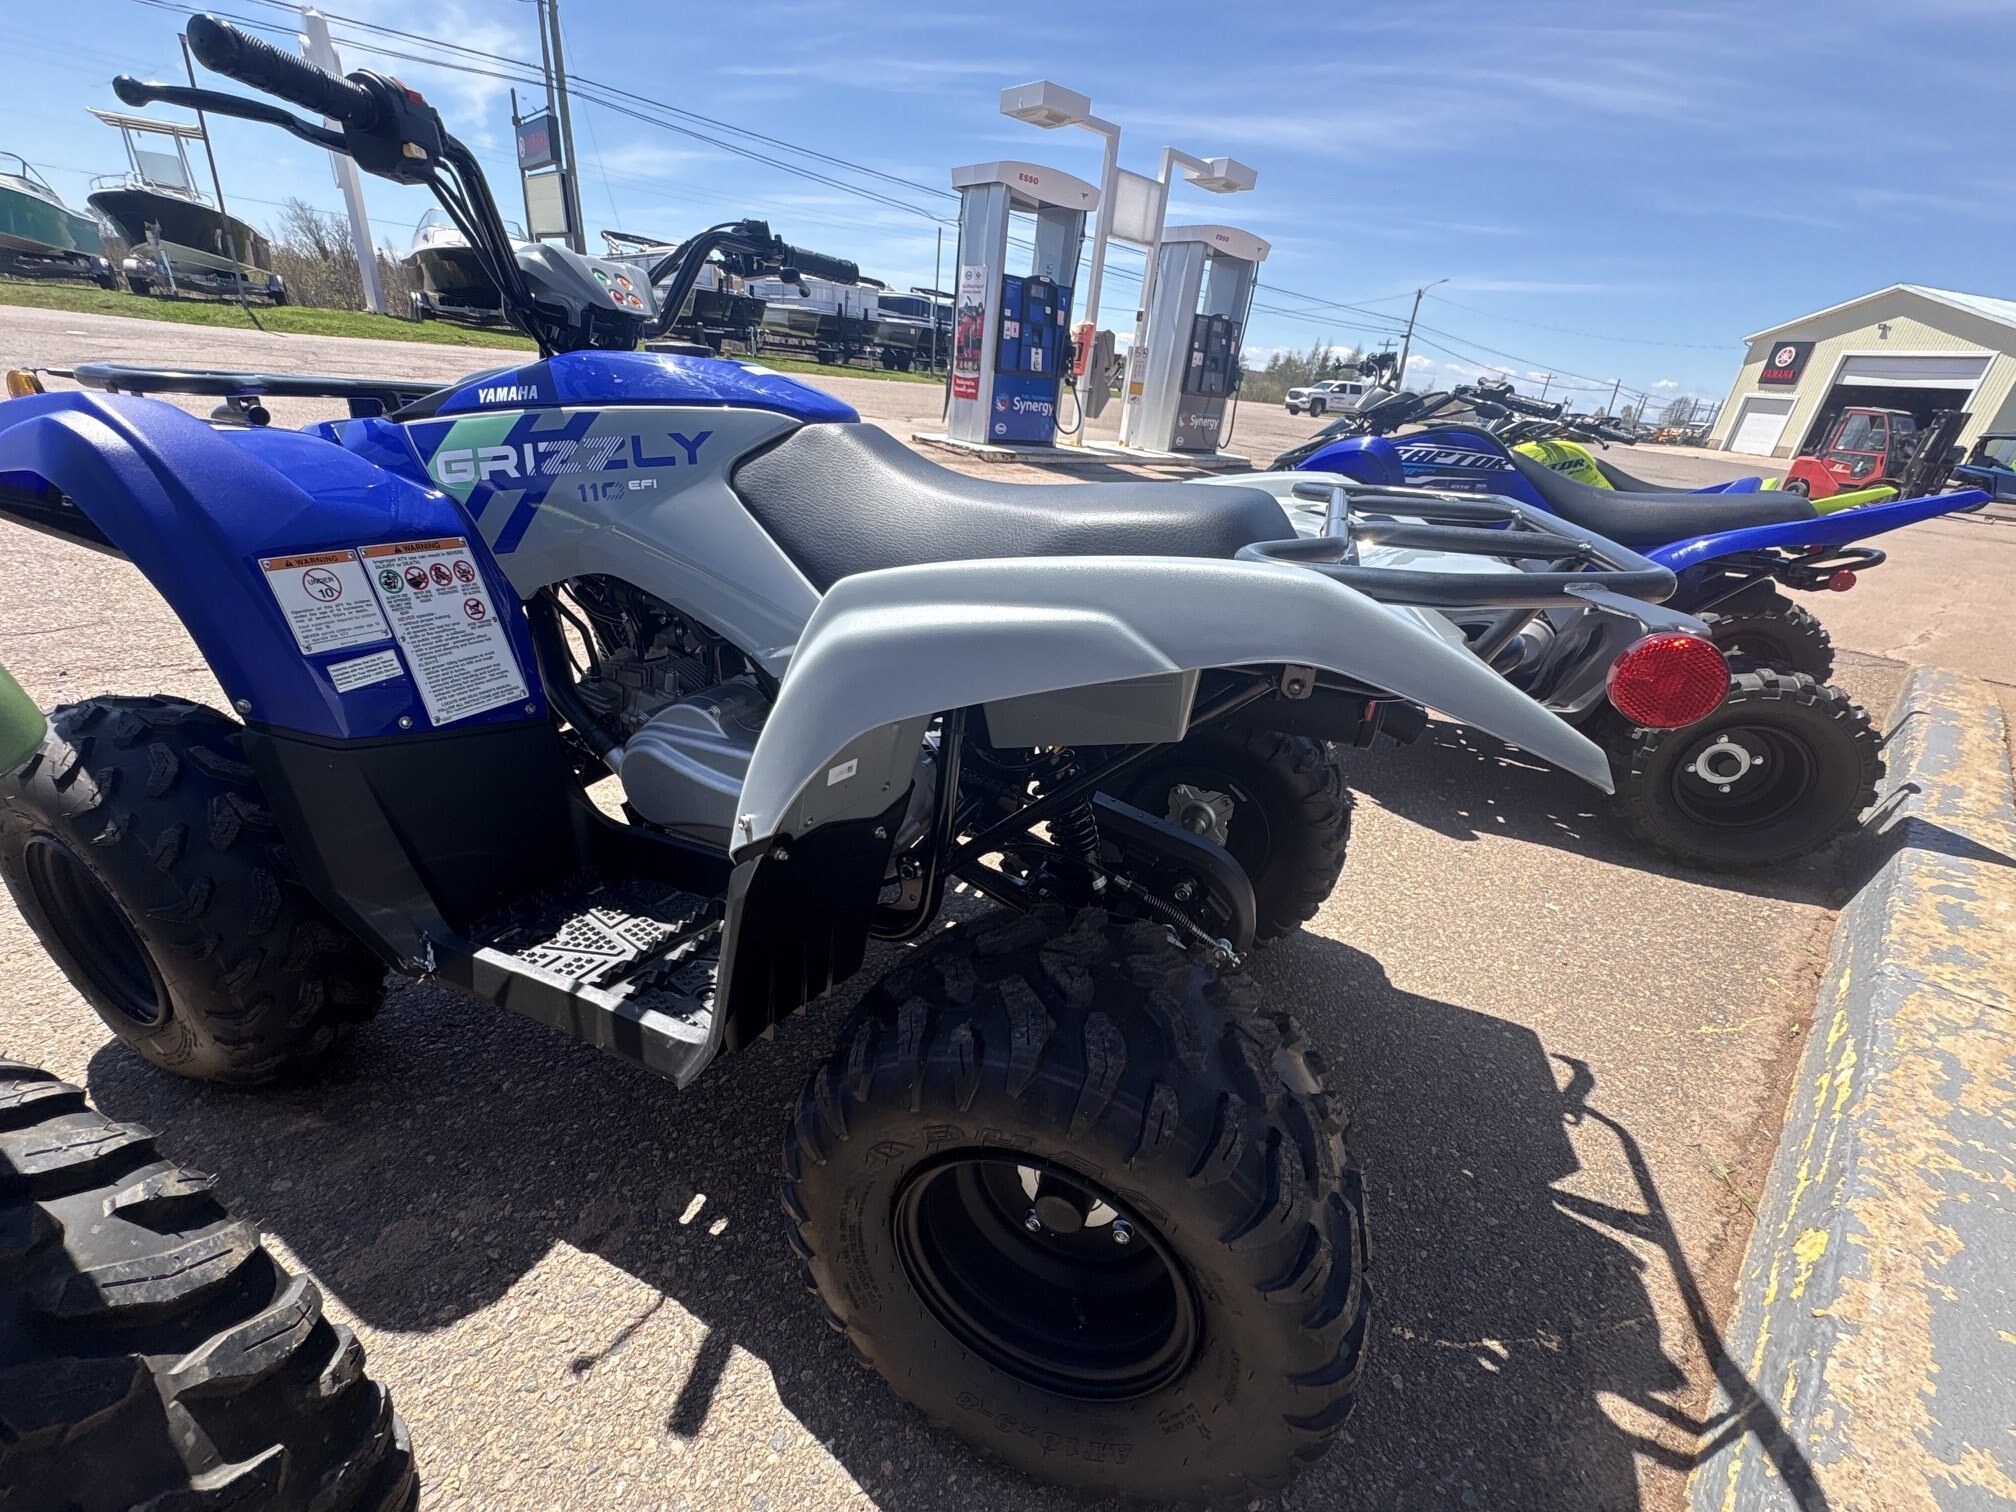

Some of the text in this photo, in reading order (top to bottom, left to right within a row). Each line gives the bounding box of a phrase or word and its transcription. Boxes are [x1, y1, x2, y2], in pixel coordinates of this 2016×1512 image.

[1018, 172, 1039, 185] ESSO
[1216, 233, 1230, 242] ESSO
[1762, 370, 1793, 379] YAMAHA
[478, 385, 538, 403] YAMAHA
[1013, 396, 1054, 417] Synergy
[1190, 414, 1219, 430] Synergy
[436, 430, 714, 484] GRIZZLY
[577, 479, 657, 503] 110 EFI
[402, 542, 440, 551] WARNING
[295, 555, 338, 565] WARNING
[308, 577, 334, 585] UNDER
[318, 587, 334, 598] 10
